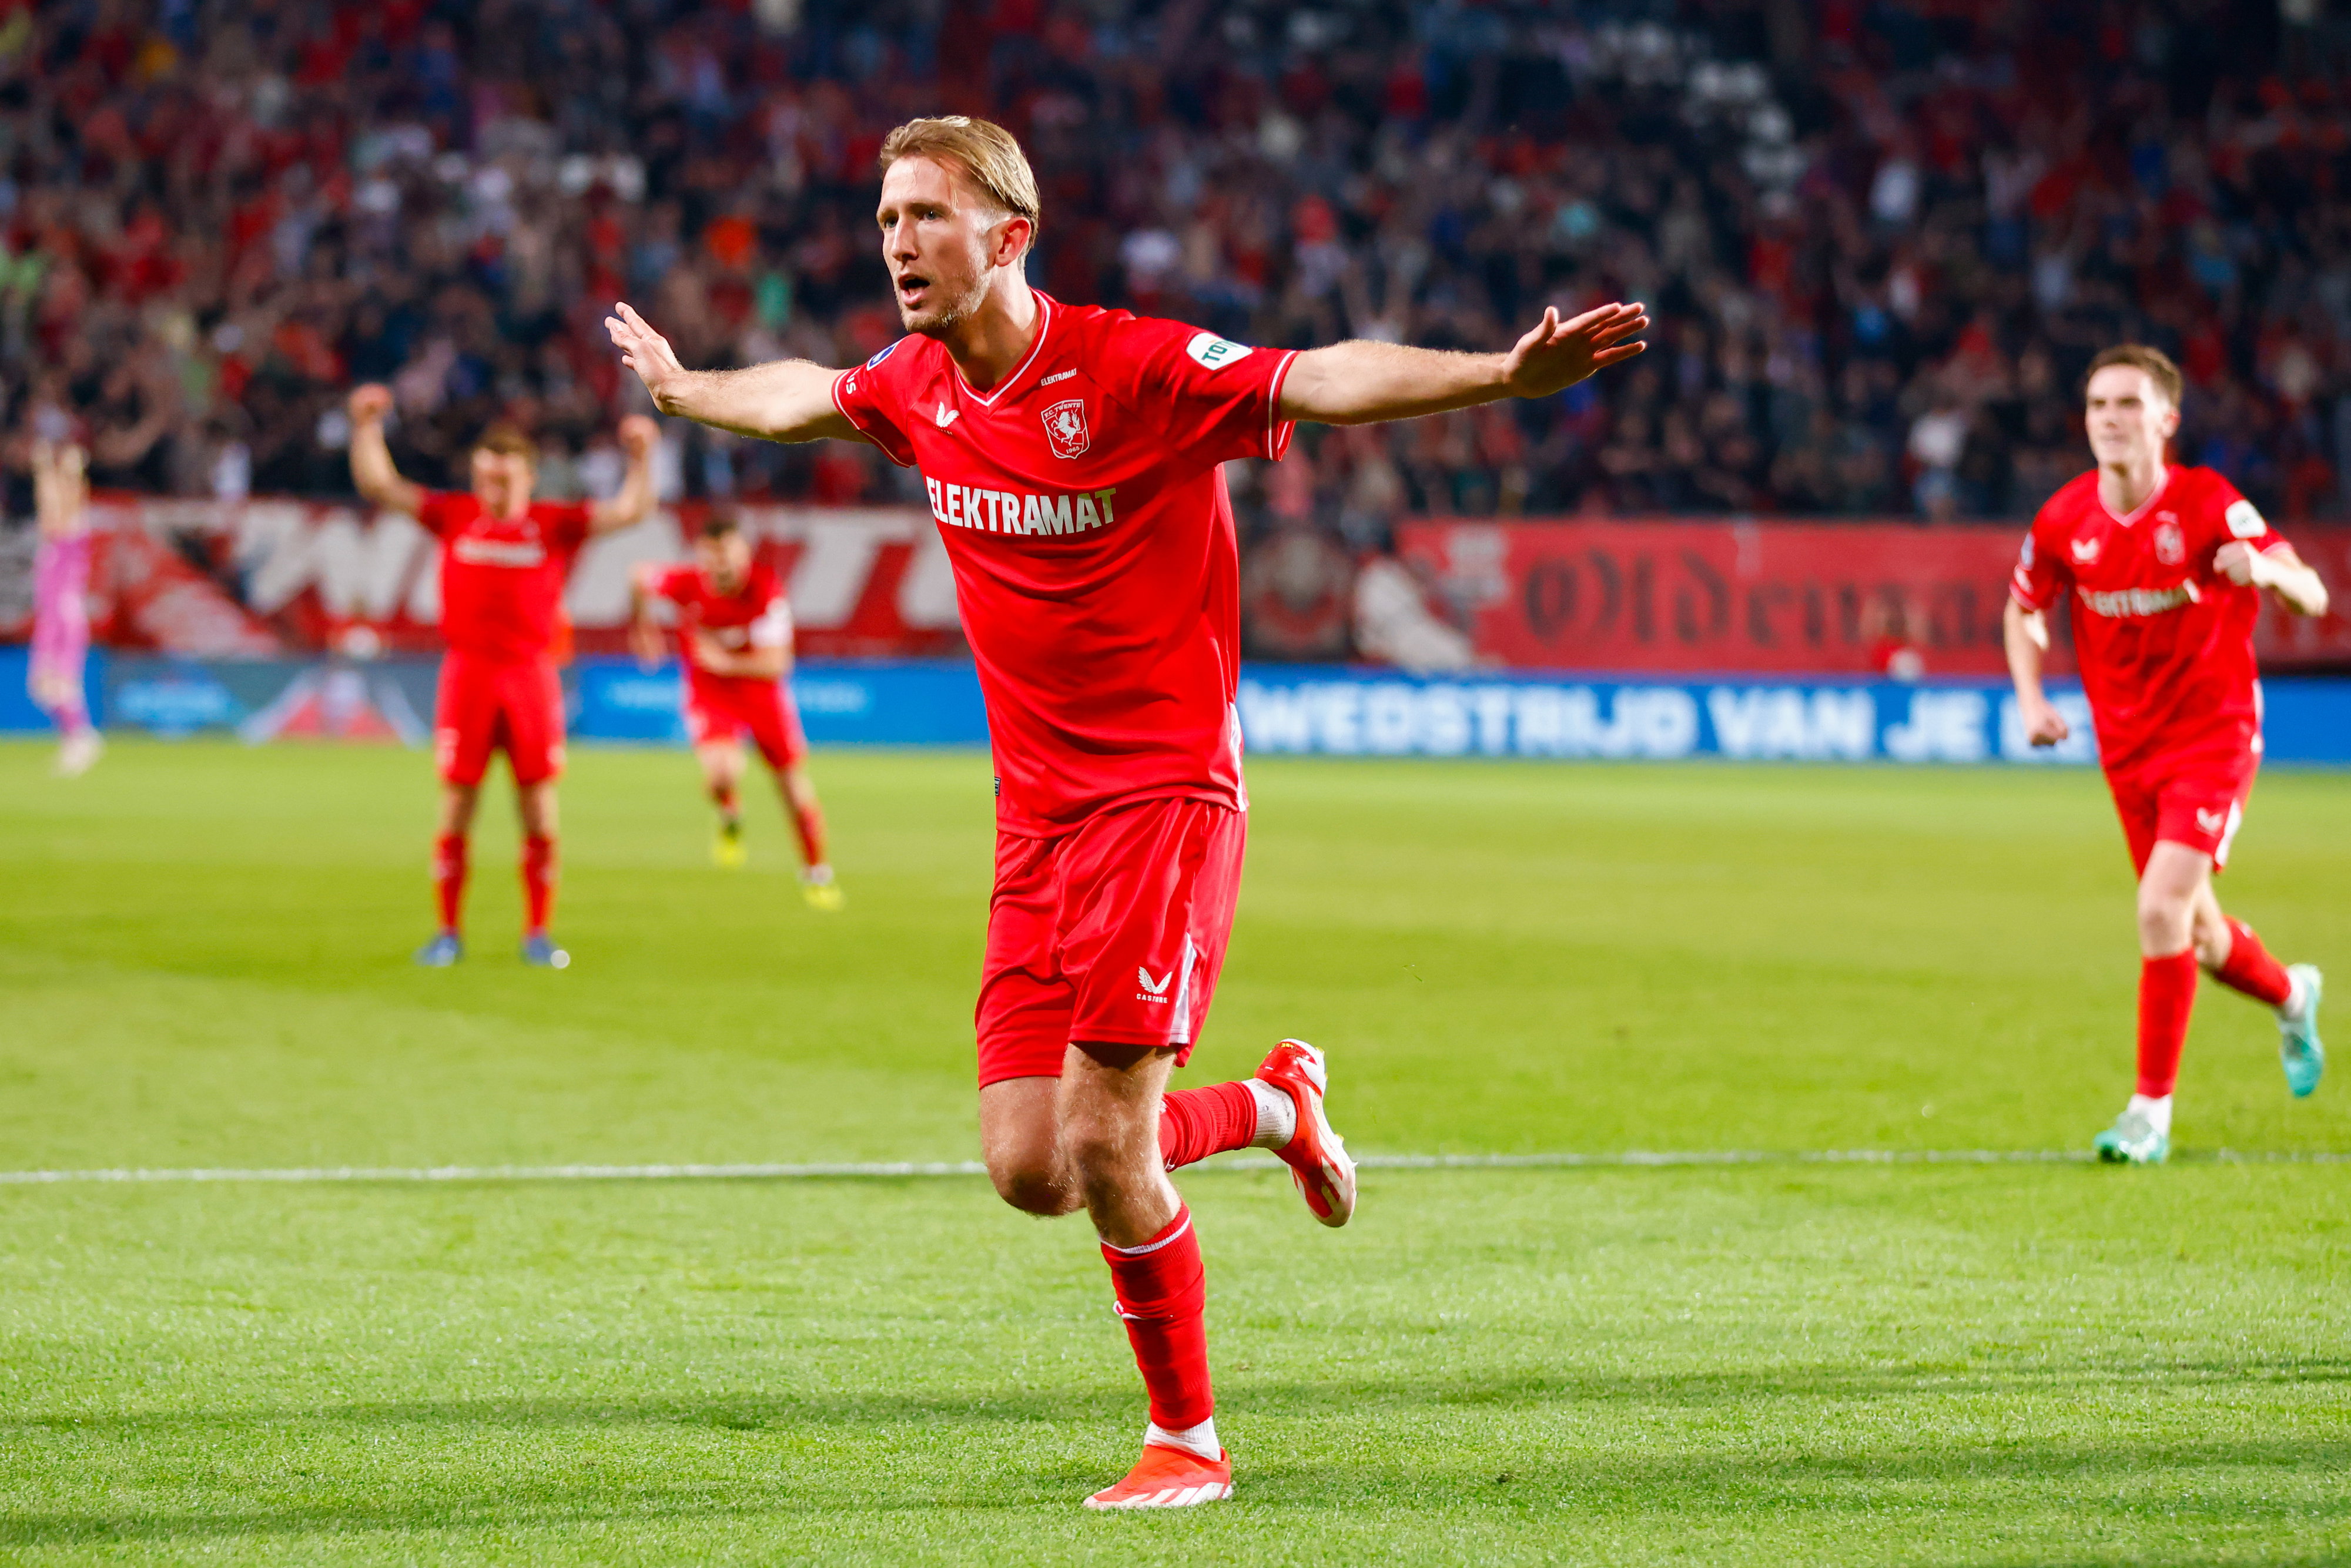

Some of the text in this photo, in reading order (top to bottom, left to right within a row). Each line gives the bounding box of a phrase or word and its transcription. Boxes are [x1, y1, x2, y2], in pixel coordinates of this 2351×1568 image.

[1041, 367, 1077, 387] ELEKTRAMAT
[1054, 402, 1081, 413] TWENTE
[1066, 445, 1080, 454] 1965
[926, 475, 1116, 535] ELEKTRAMAT
[1707, 686, 1877, 759] VAN
[1883, 689, 1988, 760] JE
[1136, 993, 1168, 1003] CASTORE
